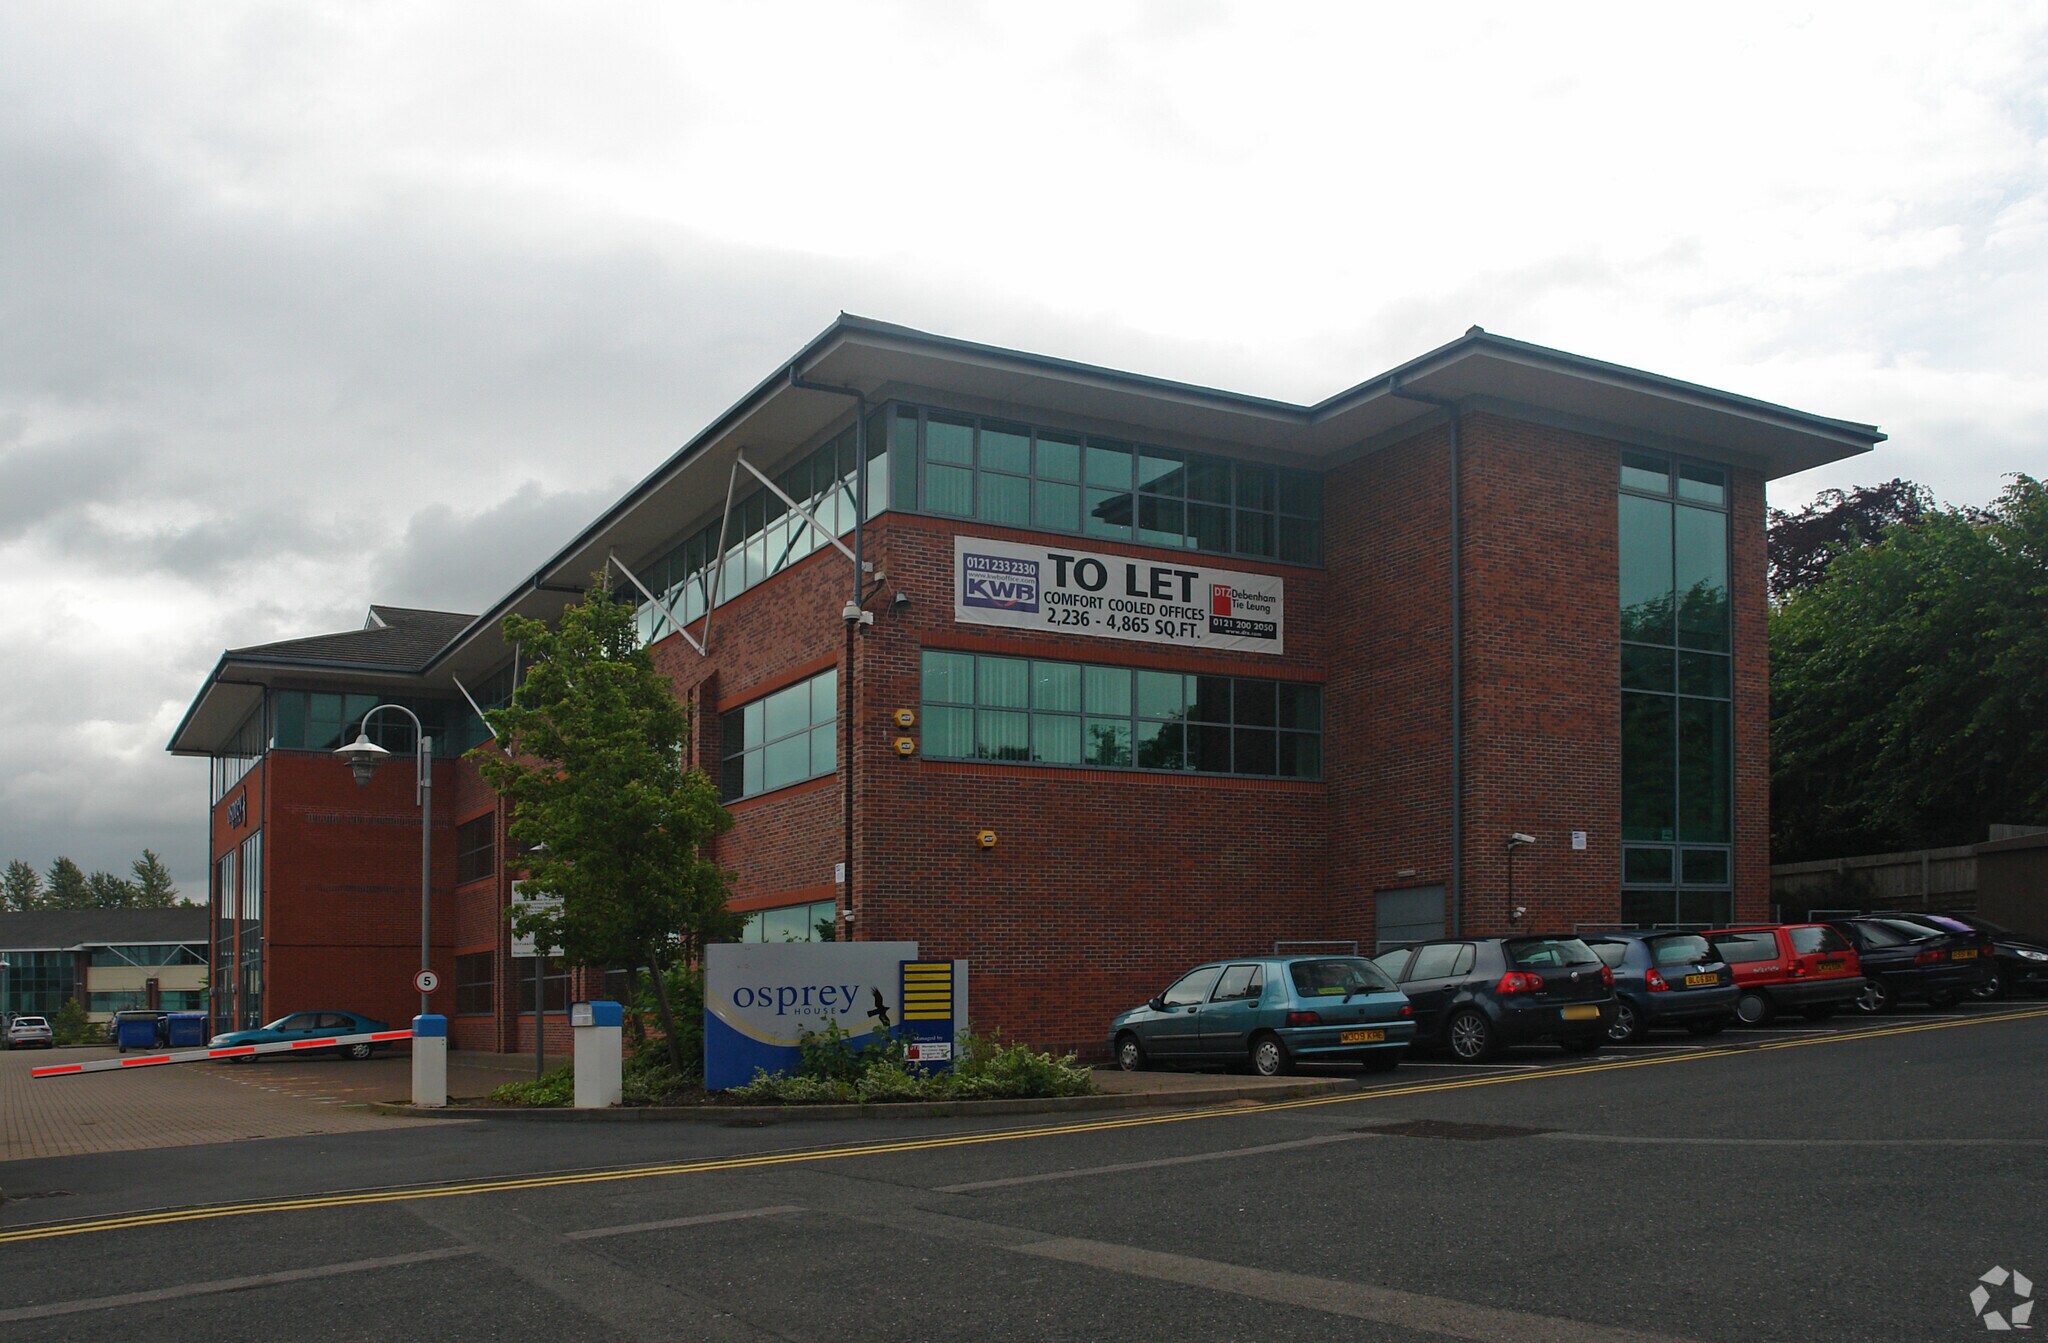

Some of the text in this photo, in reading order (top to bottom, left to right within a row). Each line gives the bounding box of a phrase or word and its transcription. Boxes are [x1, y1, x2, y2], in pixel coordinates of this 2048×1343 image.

[967, 556, 1036, 575] 0121 233 2330
[968, 572, 1035, 585] www.kwboffice.com
[1047, 553, 1199, 603] TO LET
[968, 577, 1034, 601] KWB
[1214, 586, 1232, 598] DTZ
[1232, 588, 1276, 603] Debenham
[1044, 590, 1206, 621] COMFORT COOLED OFFICES
[1232, 599, 1271, 614] Tie Leung
[1047, 608, 1090, 627] 2,236
[1106, 614, 1150, 635] 4,865
[1155, 620, 1201, 640] SQ.FT.
[1213, 617, 1274, 632] 0121 200 2050
[423, 976, 431, 986] 5
[733, 983, 860, 1017] osprey
[794, 1006, 837, 1016] HOUSE
